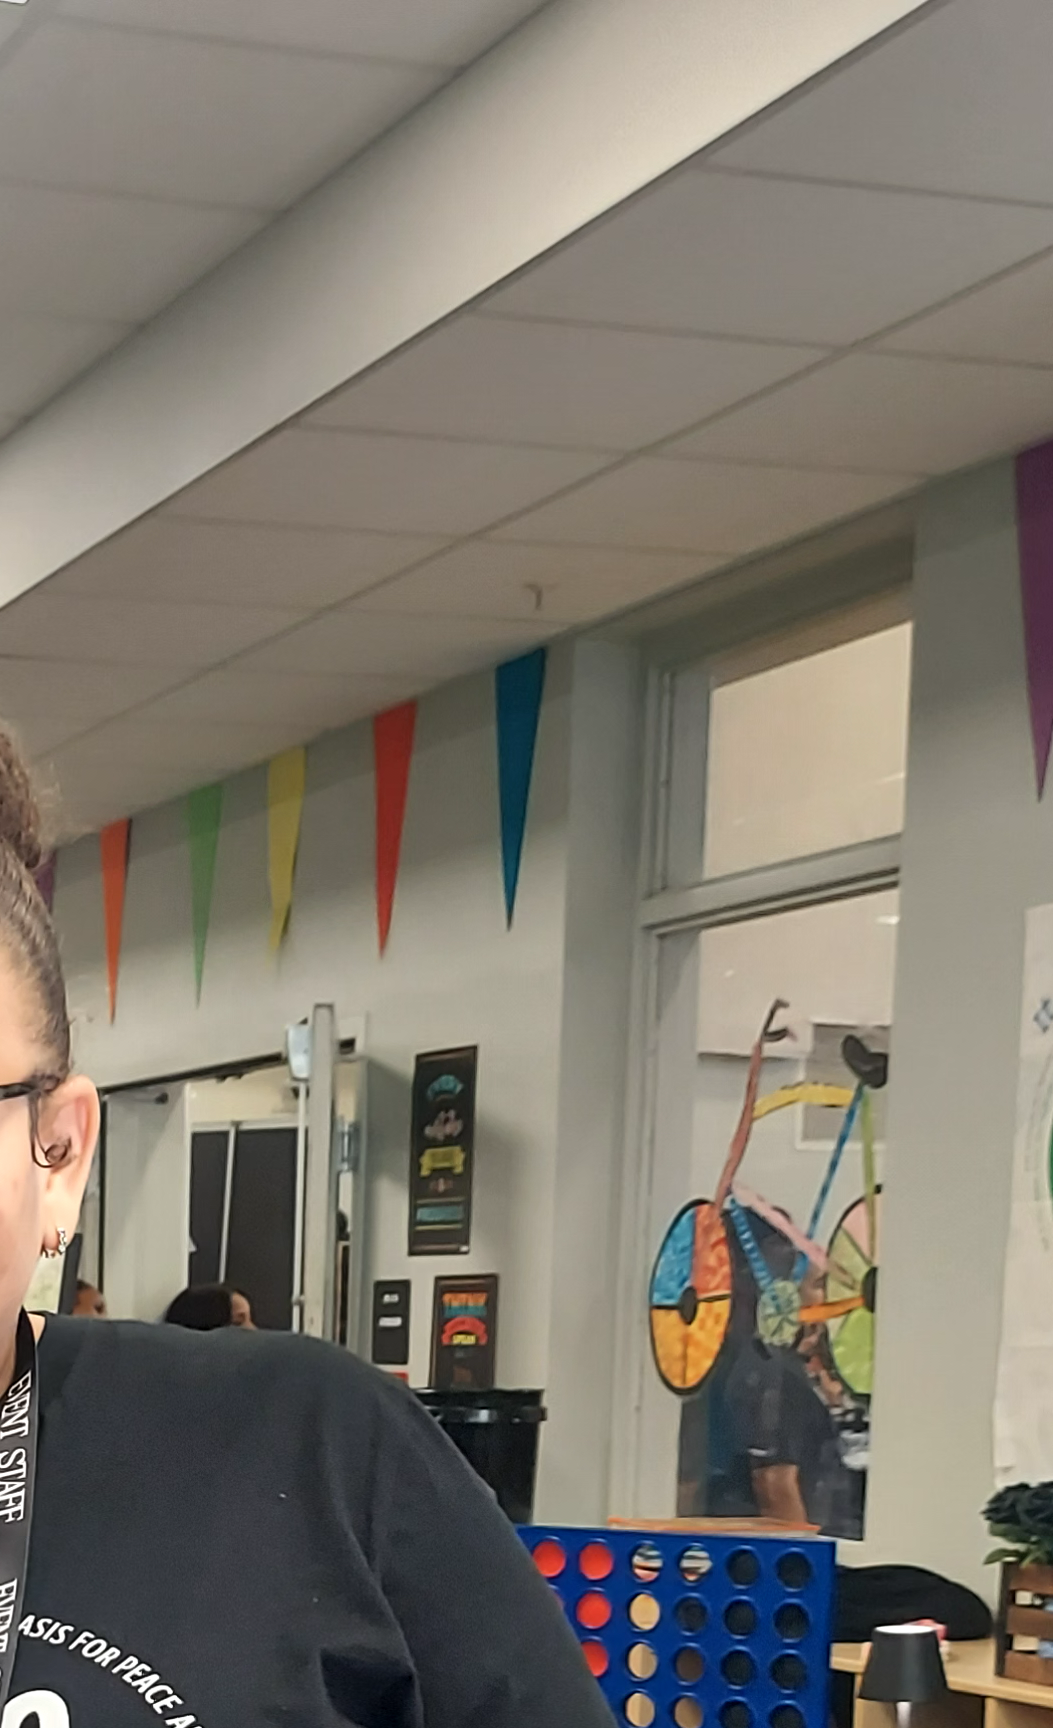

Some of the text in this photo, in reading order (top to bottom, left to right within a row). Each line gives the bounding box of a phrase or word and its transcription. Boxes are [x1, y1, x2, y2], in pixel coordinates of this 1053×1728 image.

[0, 1369, 32, 1441] EVENT
[18, 1614, 75, 1645] ASIS
[68, 1630, 122, 1668] FOR
[111, 1655, 184, 1715] PEACE
